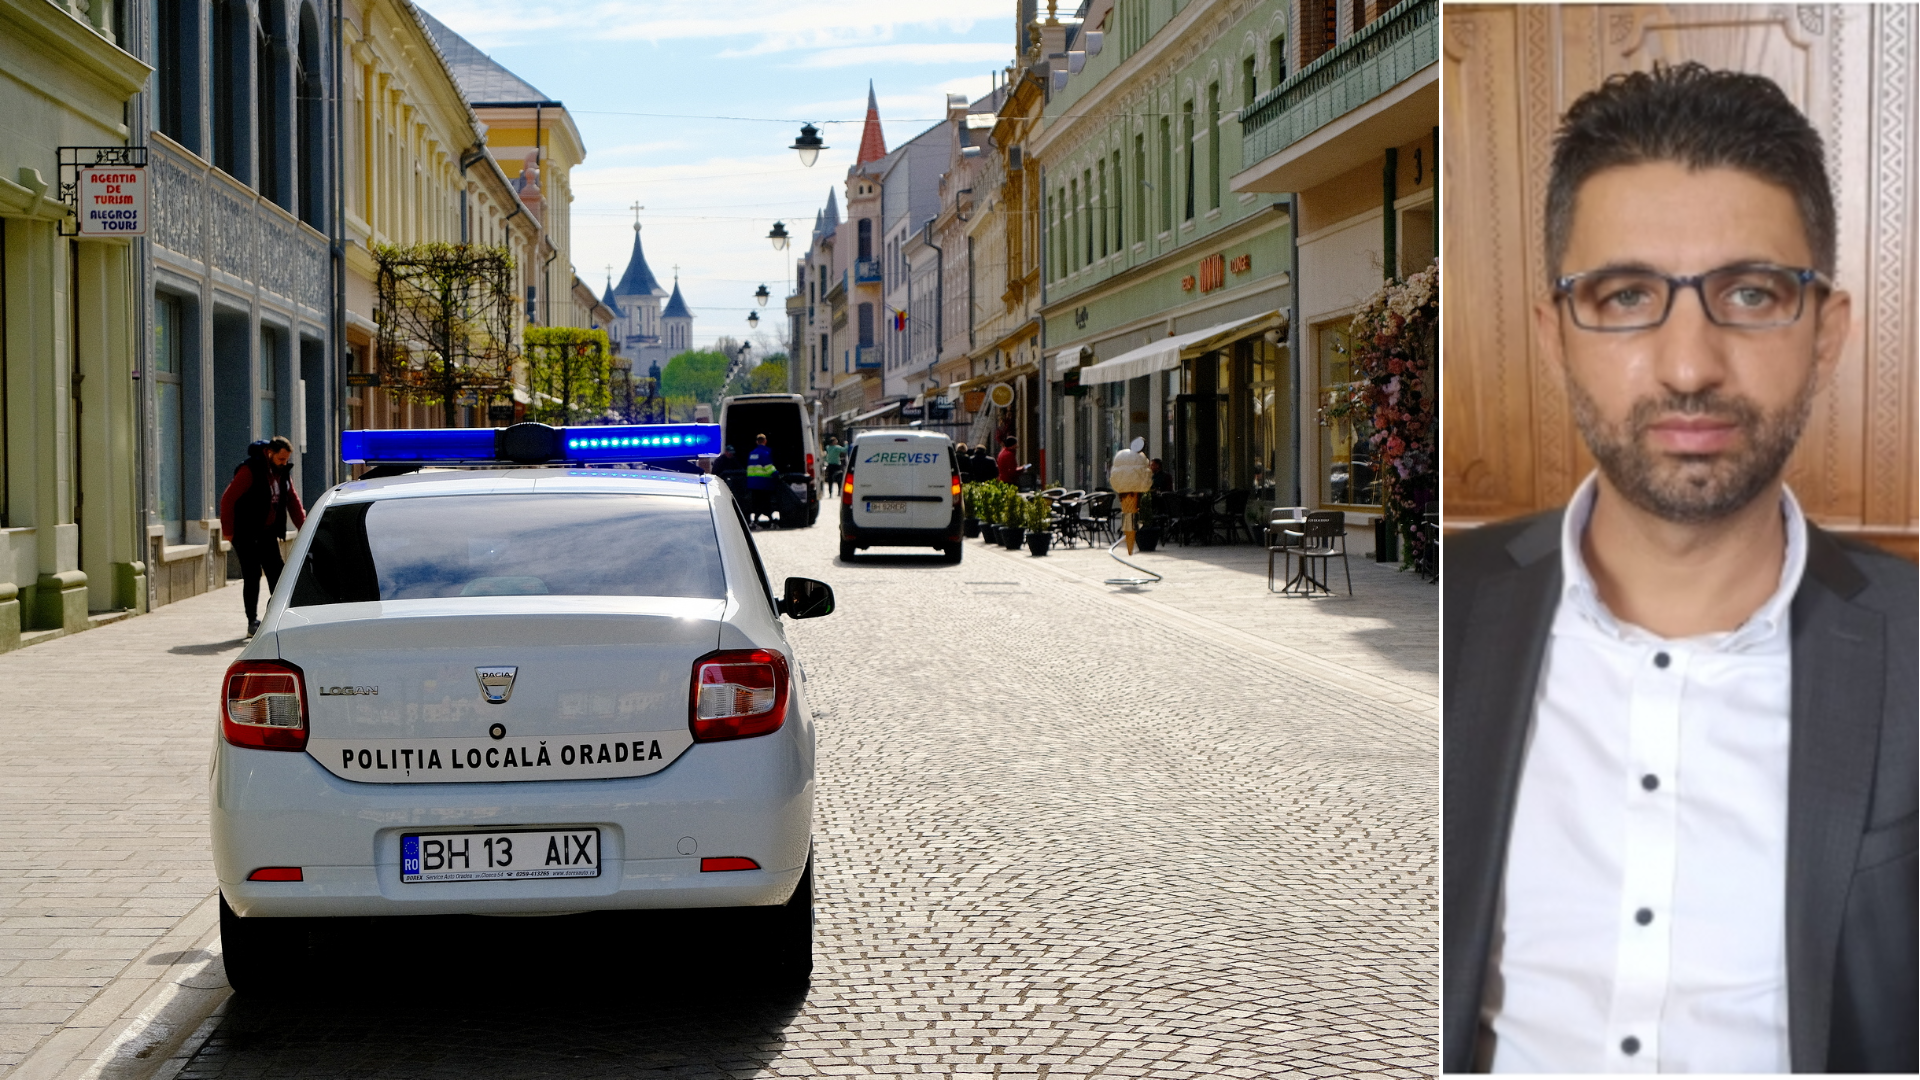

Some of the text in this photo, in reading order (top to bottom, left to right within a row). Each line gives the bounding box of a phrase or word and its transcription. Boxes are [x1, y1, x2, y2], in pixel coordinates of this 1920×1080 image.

[91, 174, 137, 183] AGENTIA
[106, 185, 121, 194] DE
[94, 195, 134, 205] TURISM
[90, 210, 137, 219] ALEGROS
[102, 221, 137, 230] TOURS
[319, 685, 379, 696] LOGAN
[342, 739, 663, 777] POLIȚIA LOCALĂ ORADEA
[404, 834, 593, 871] RO BH 13 AIX
